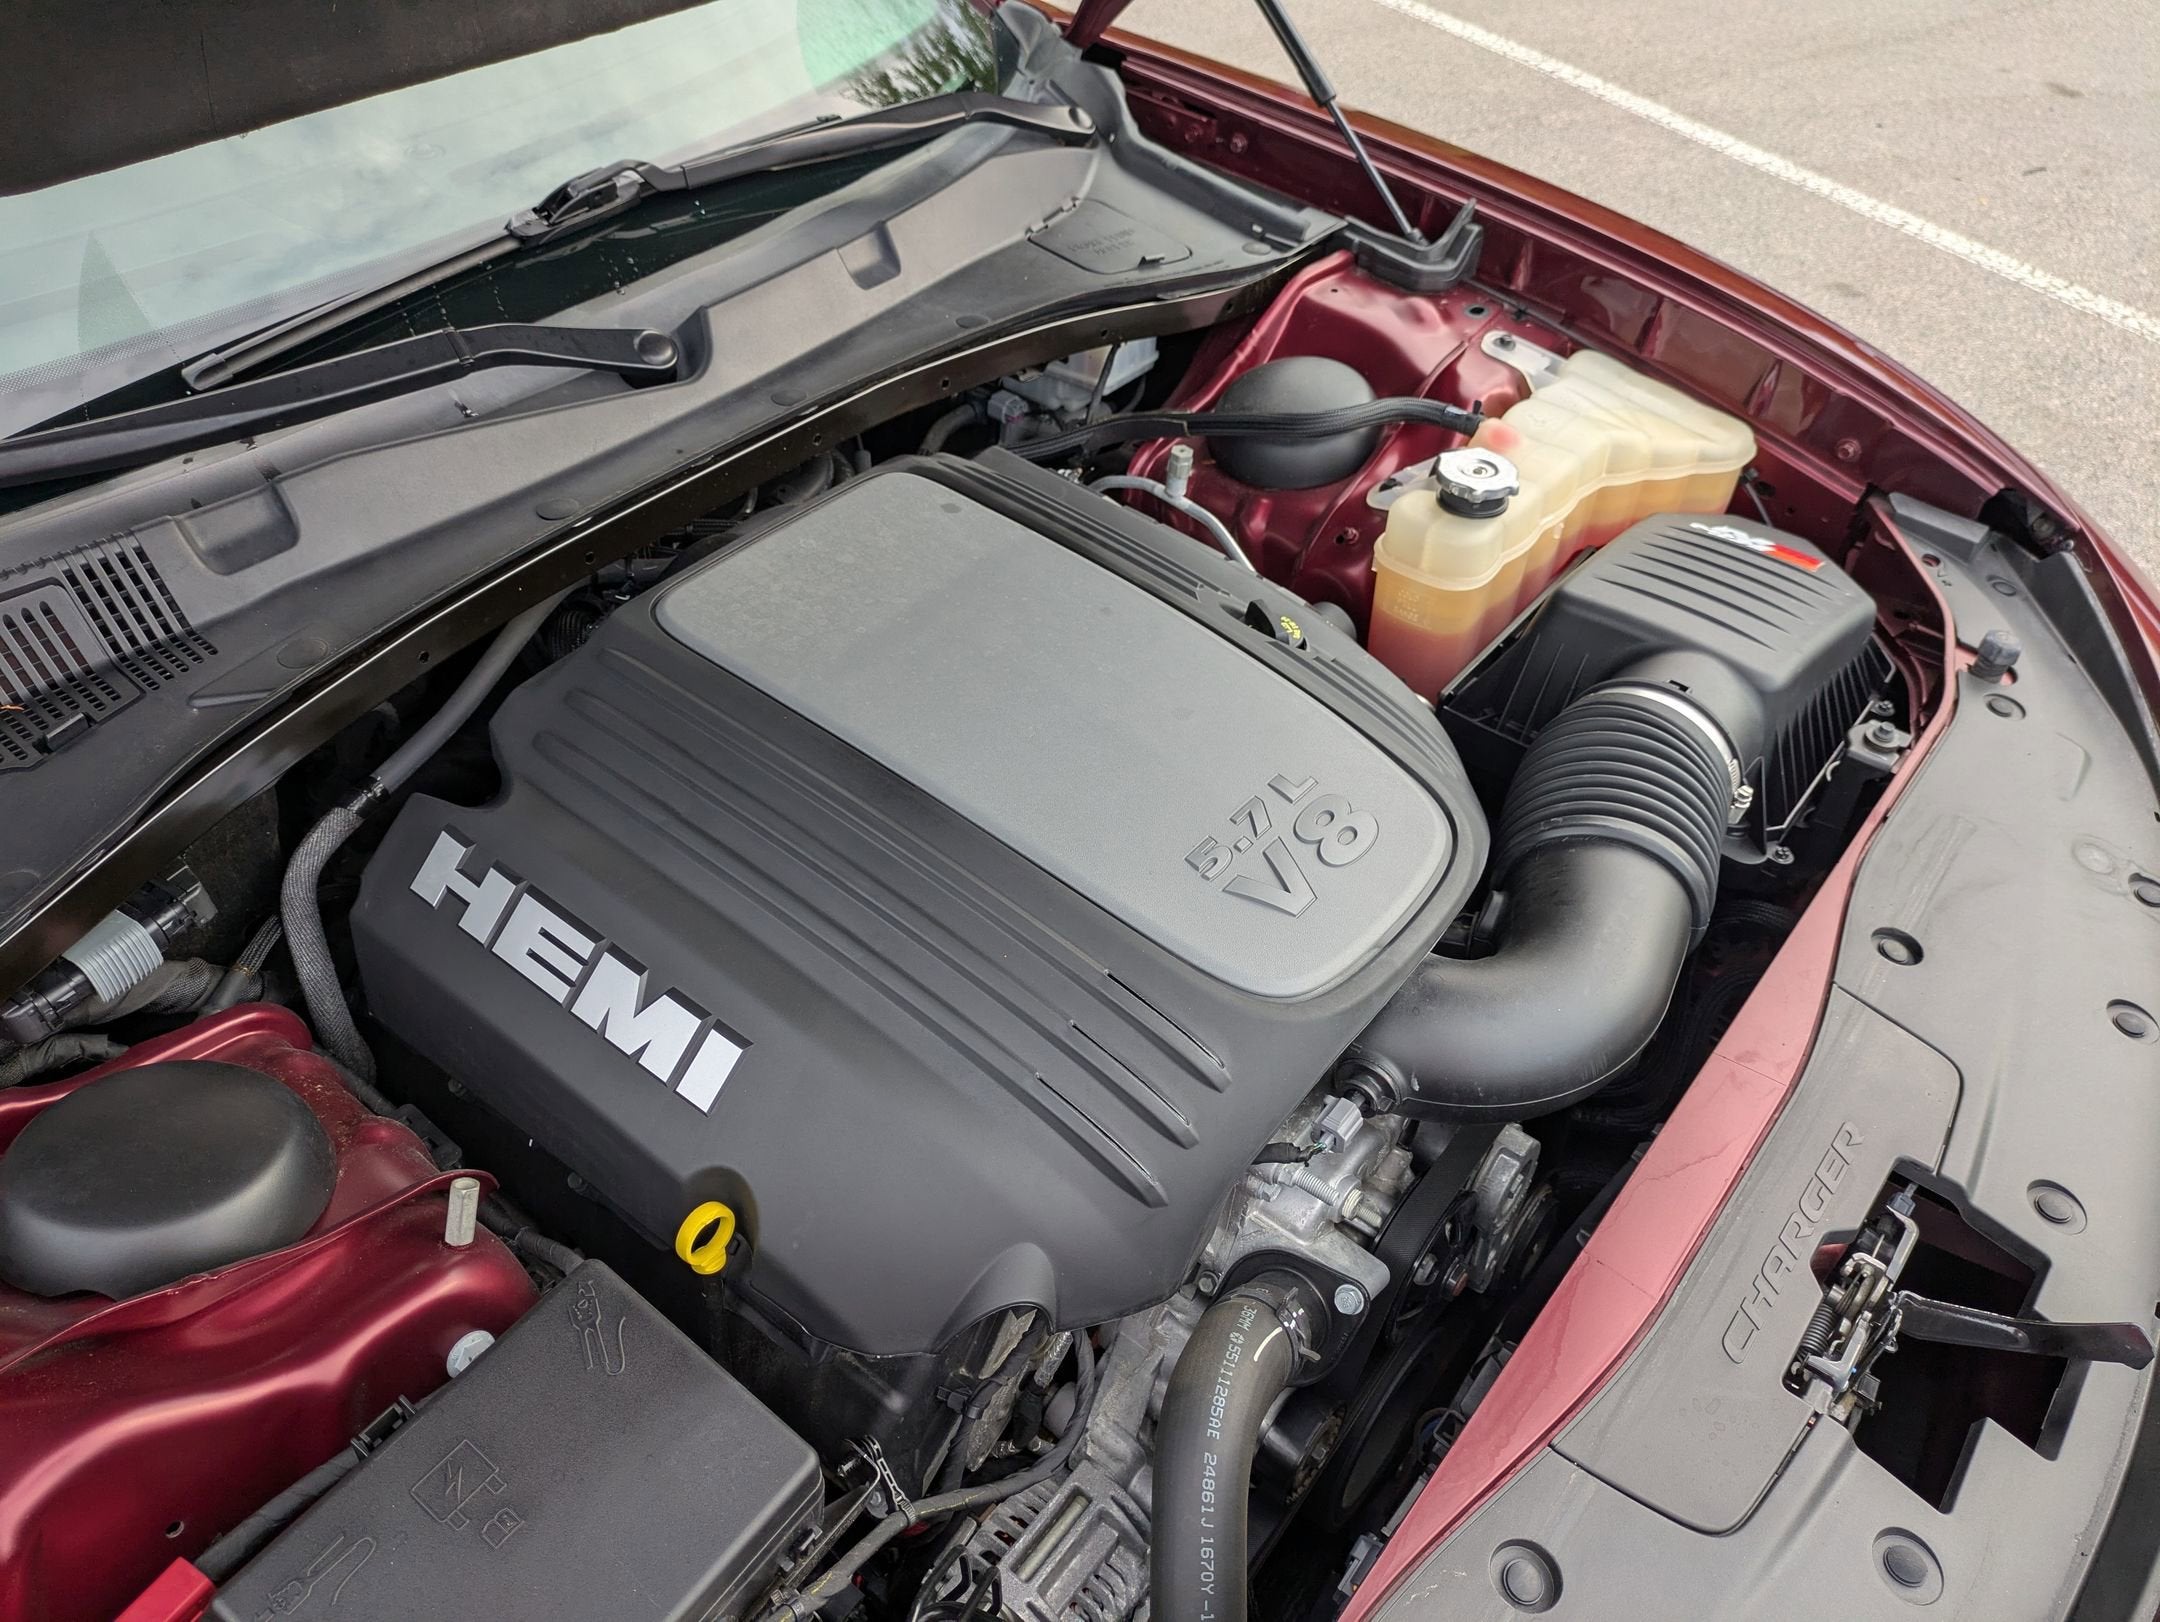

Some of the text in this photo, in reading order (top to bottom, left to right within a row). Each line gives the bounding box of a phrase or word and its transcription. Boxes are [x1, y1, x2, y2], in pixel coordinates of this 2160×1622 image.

[1221, 793, 1380, 919] V8
[408, 824, 755, 1118] HEMI
[1721, 1121, 1865, 1365] CHARGER
[1206, 1343, 1242, 1441] 55111285AE
[1200, 1452, 1217, 1528] 24861J
[1200, 1536, 1215, 1595] 1670Y
